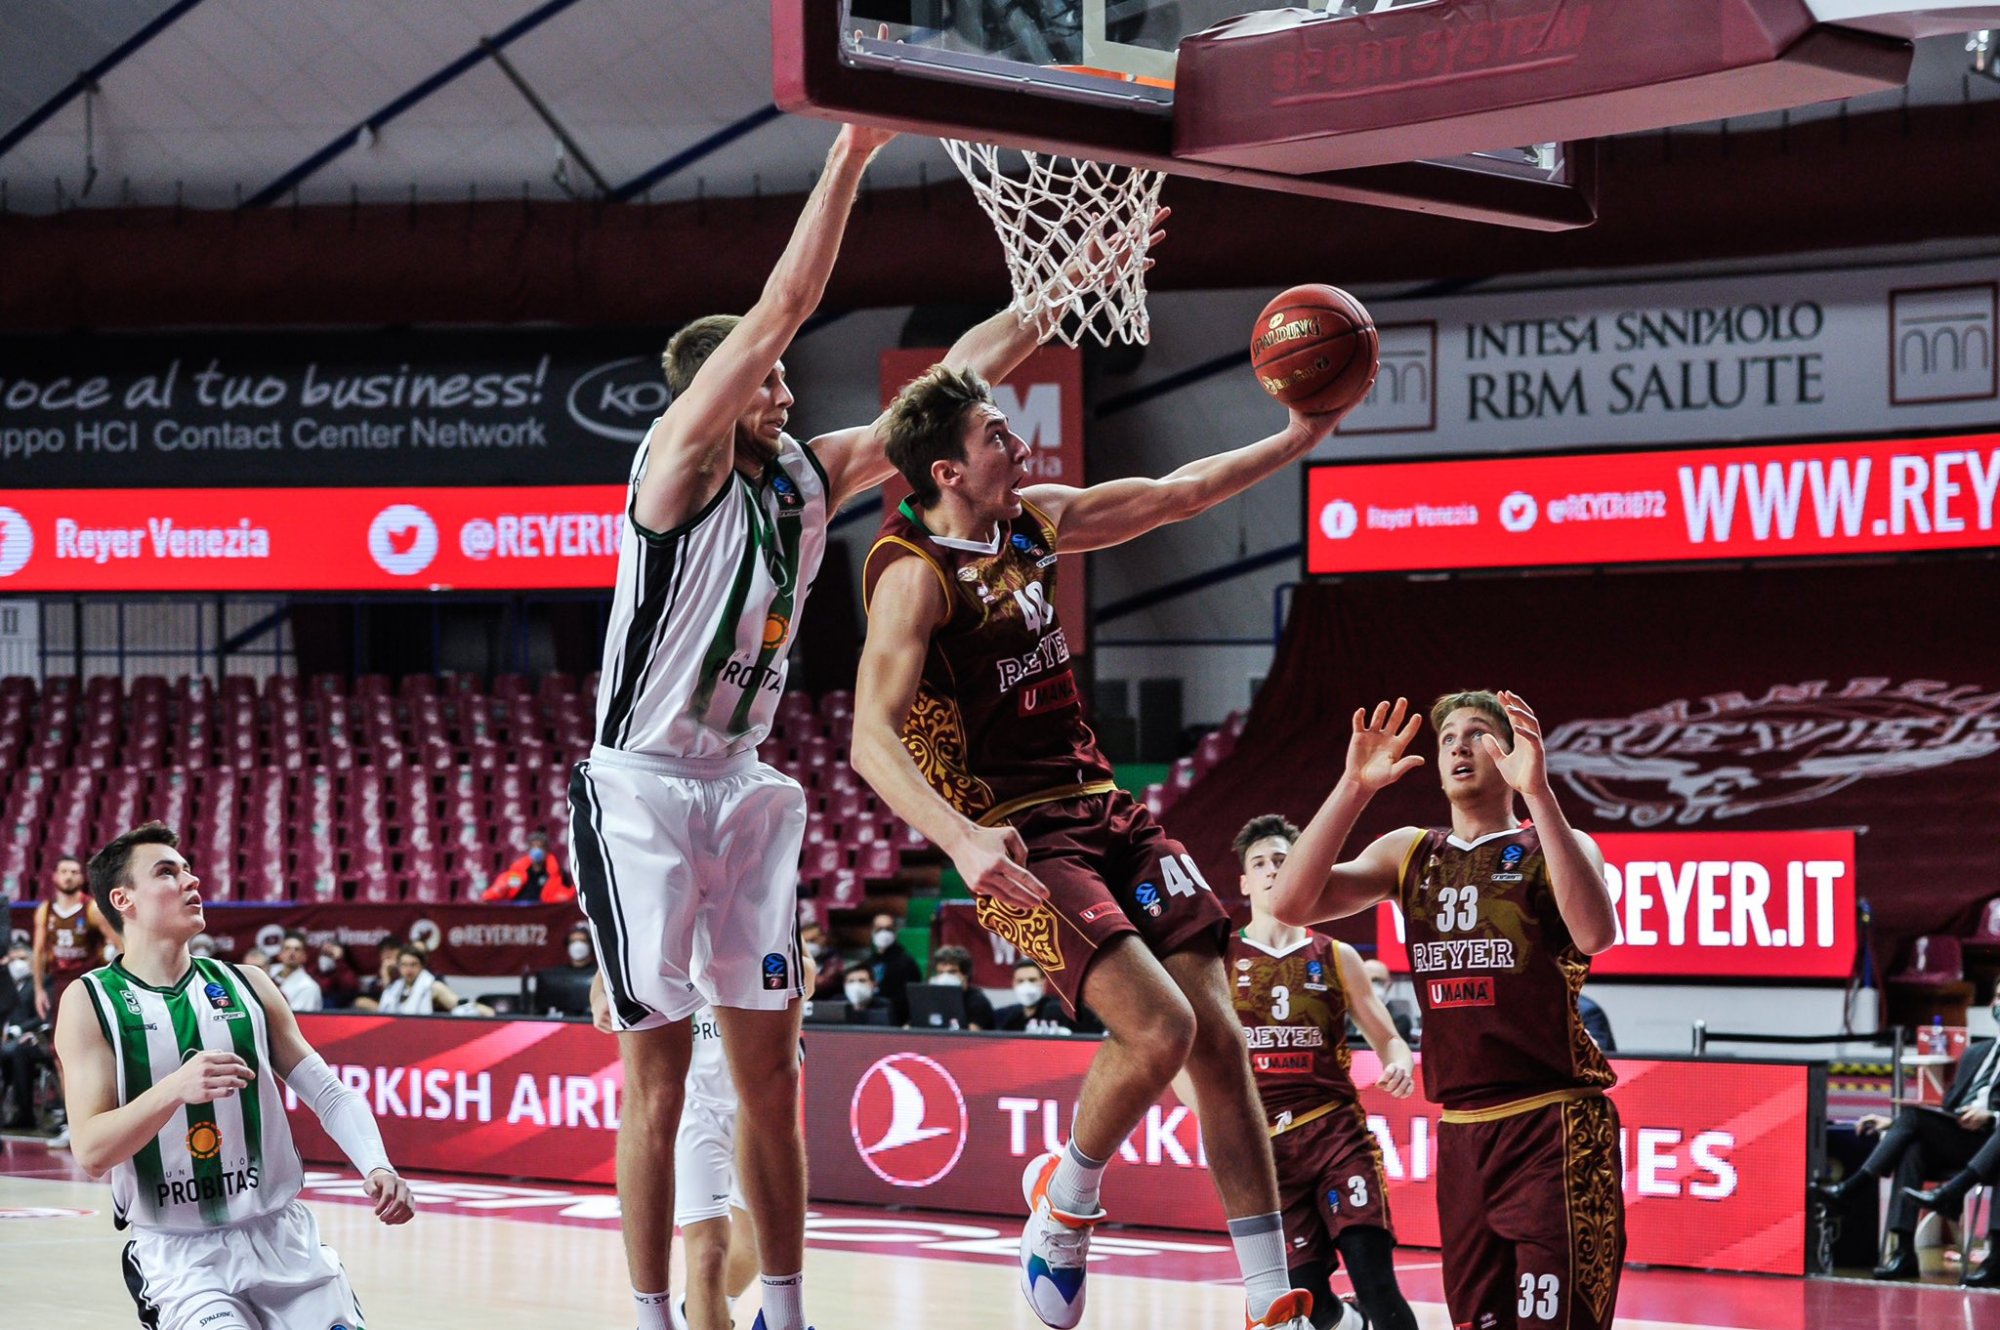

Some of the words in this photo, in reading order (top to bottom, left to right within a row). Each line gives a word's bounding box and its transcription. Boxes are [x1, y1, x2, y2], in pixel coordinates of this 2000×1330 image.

[1272, 41, 1406, 92] SPORT
[1414, 5, 1592, 75] SYSTEM
[1466, 316, 1600, 360] INTESA
[1614, 301, 1823, 350] SANPAOLO
[0, 377, 112, 411] oce
[124, 358, 180, 409] al
[194, 358, 288, 409] tuo
[300, 353, 549, 409] business!
[600, 381, 670, 416] KO
[1467, 368, 1588, 421] RBM
[1608, 354, 1824, 415] SALUTE
[0, 426, 65, 458] ppo
[74, 420, 138, 452] HCI
[153, 419, 282, 450] Contact
[291, 418, 403, 449] Center
[410, 416, 547, 447] Network
[1677, 447, 2000, 543] WWW.REY
[56, 518, 146, 564] Reyer
[148, 517, 269, 558] Venezia
[996, 627, 1070, 694] REYE
[1158, 852, 1213, 898] 40
[1436, 885, 1479, 932] 33
[1413, 938, 1515, 973] REYER
[1271, 985, 1290, 1020] 3
[1431, 981, 1489, 1004] UMANA
[1243, 1026, 1324, 1049] REYER
[284, 1063, 491, 1122] RKISH
[506, 1072, 622, 1131] AIRL
[157, 1166, 259, 1208] PROBITAS
[1347, 1175, 1368, 1208] 3
[1517, 1272, 1560, 1321] 33
